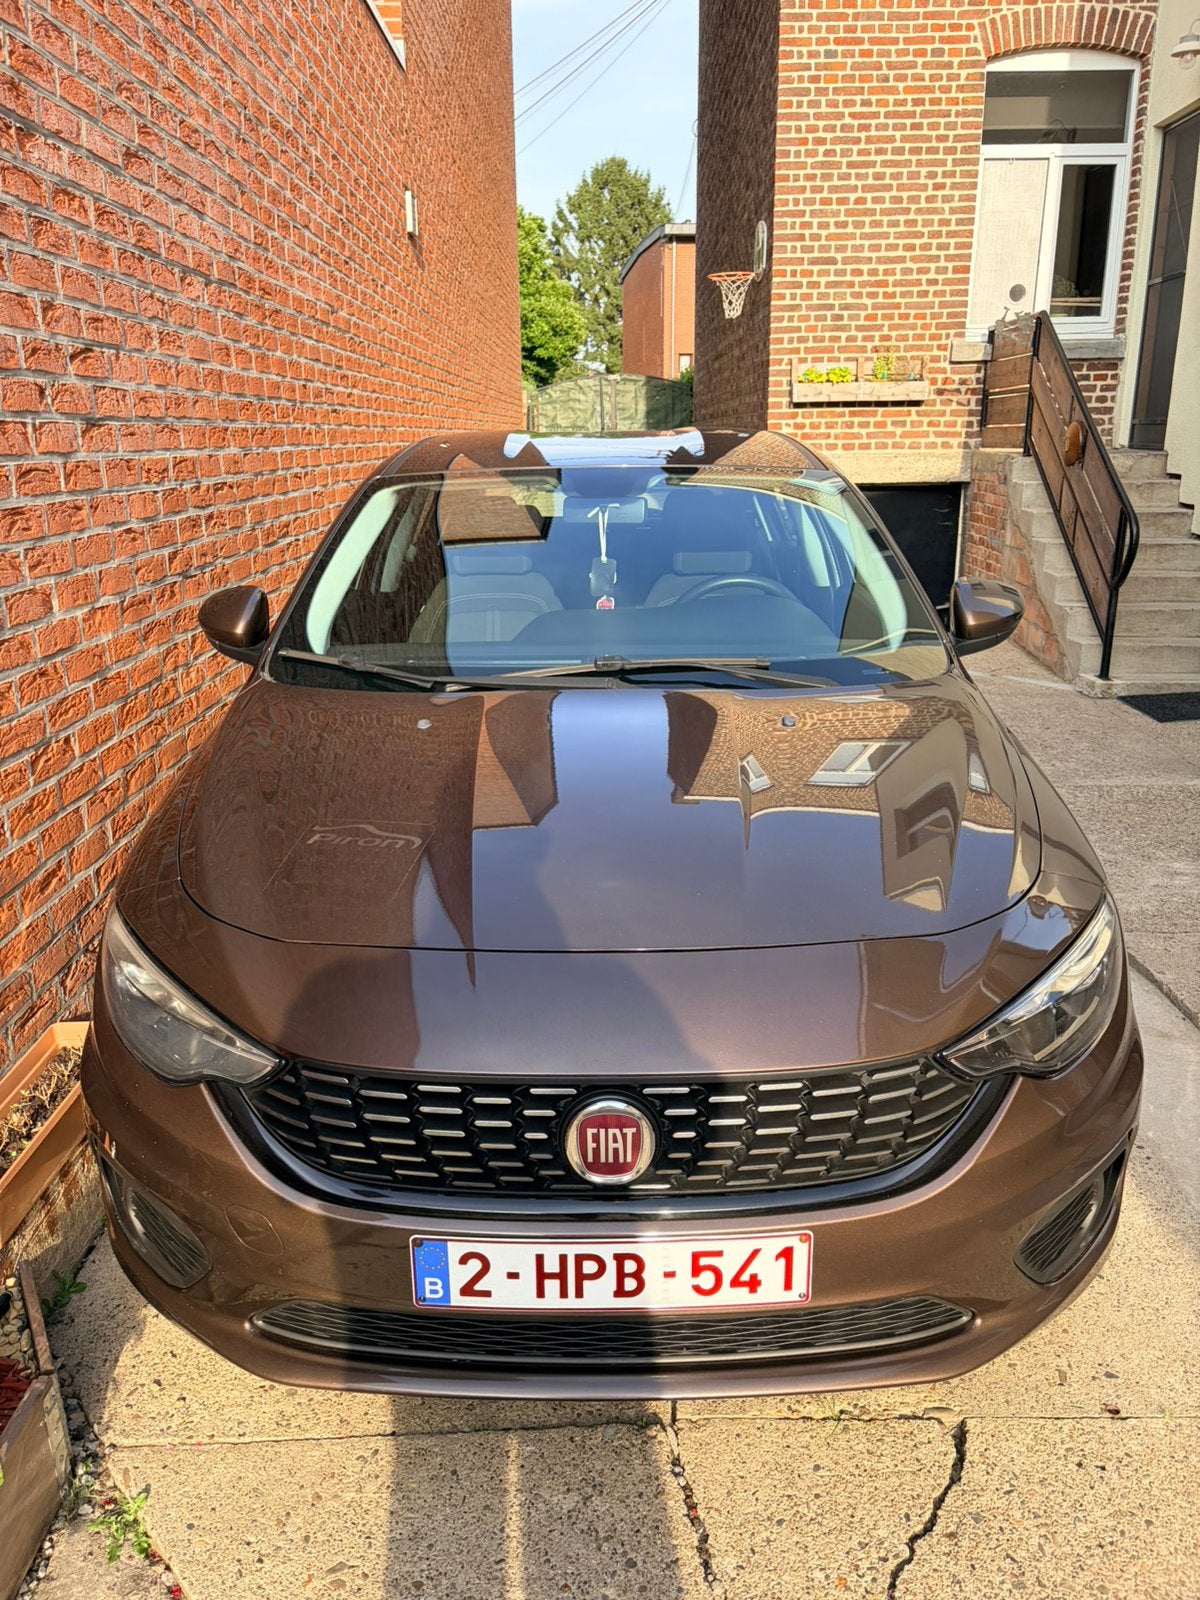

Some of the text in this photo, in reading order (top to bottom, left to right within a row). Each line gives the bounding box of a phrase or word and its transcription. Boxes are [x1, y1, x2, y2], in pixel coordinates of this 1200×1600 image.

[306, 833, 405, 848] Piron
[586, 1127, 636, 1163] FIAT
[424, 1277, 444, 1299] B
